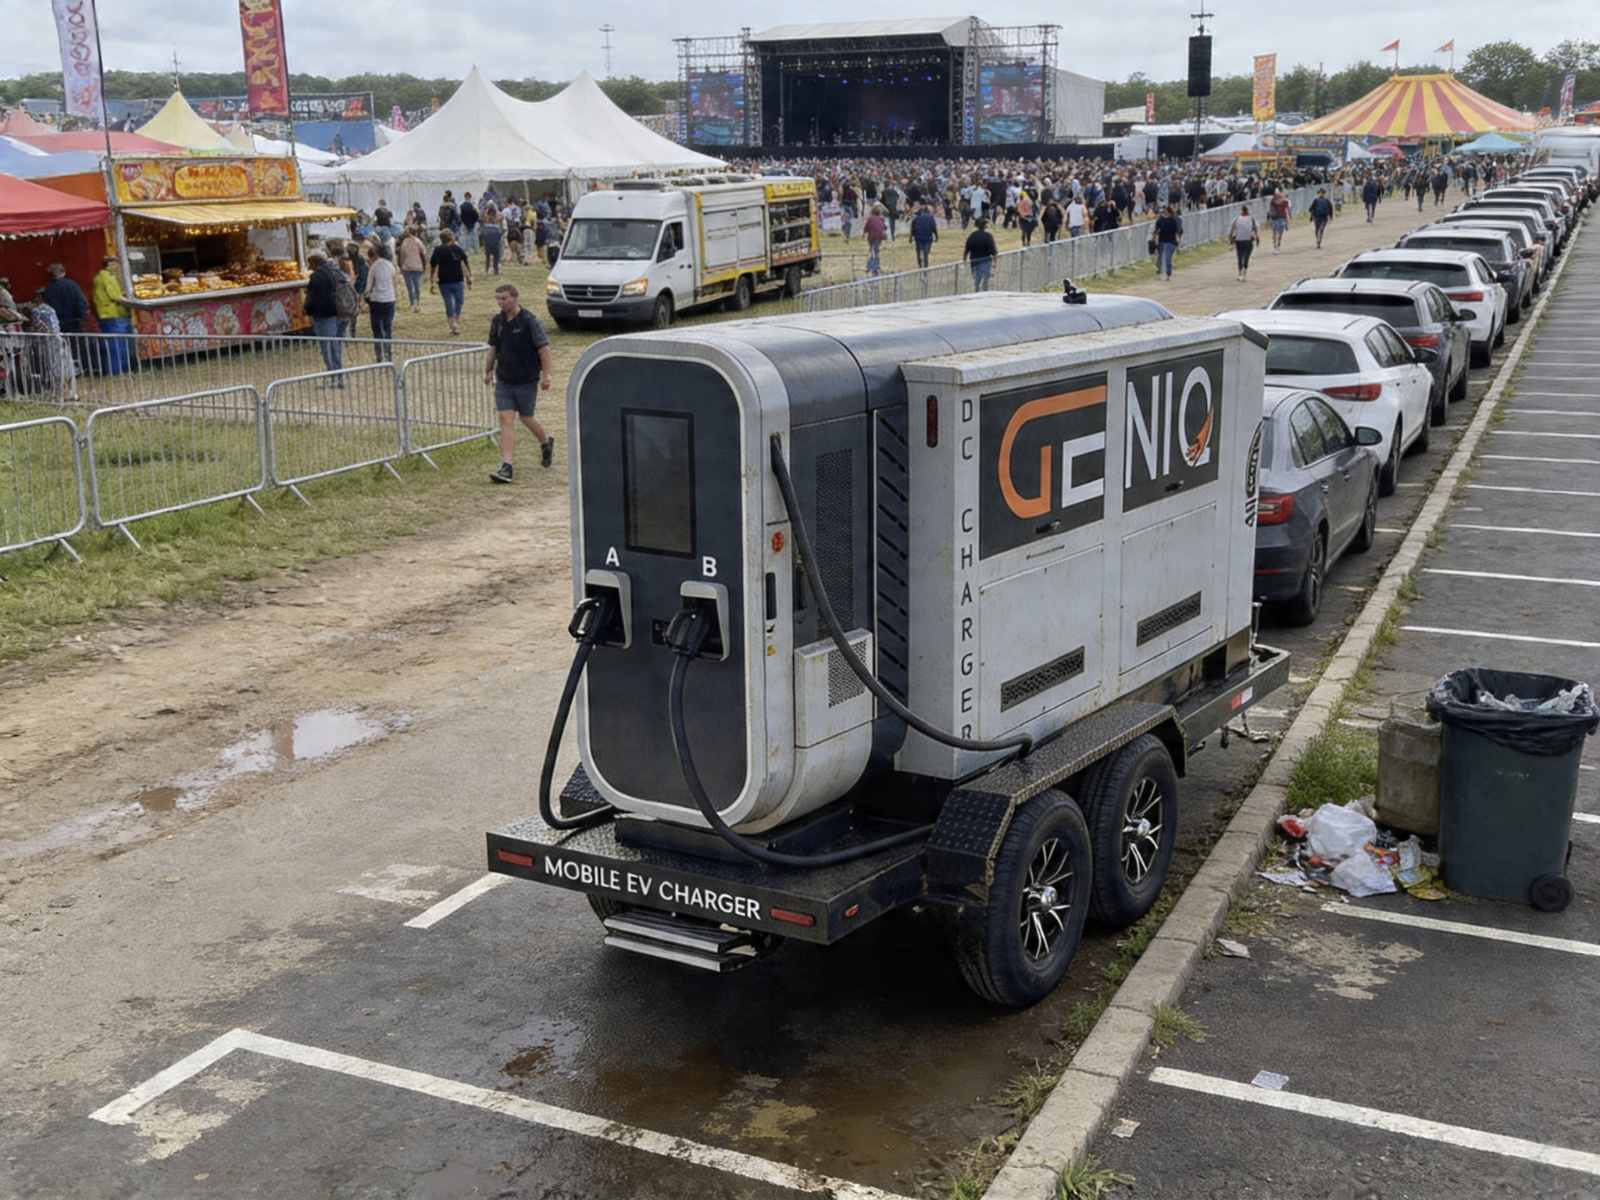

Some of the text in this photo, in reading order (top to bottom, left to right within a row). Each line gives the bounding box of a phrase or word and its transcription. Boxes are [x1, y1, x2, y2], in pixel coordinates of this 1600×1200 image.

[605, 546, 621, 568] A
[702, 555, 718, 578] B
[960, 399, 974, 740] DC CHARGER
[544, 855, 762, 921] MOBILE EV CHARGER
